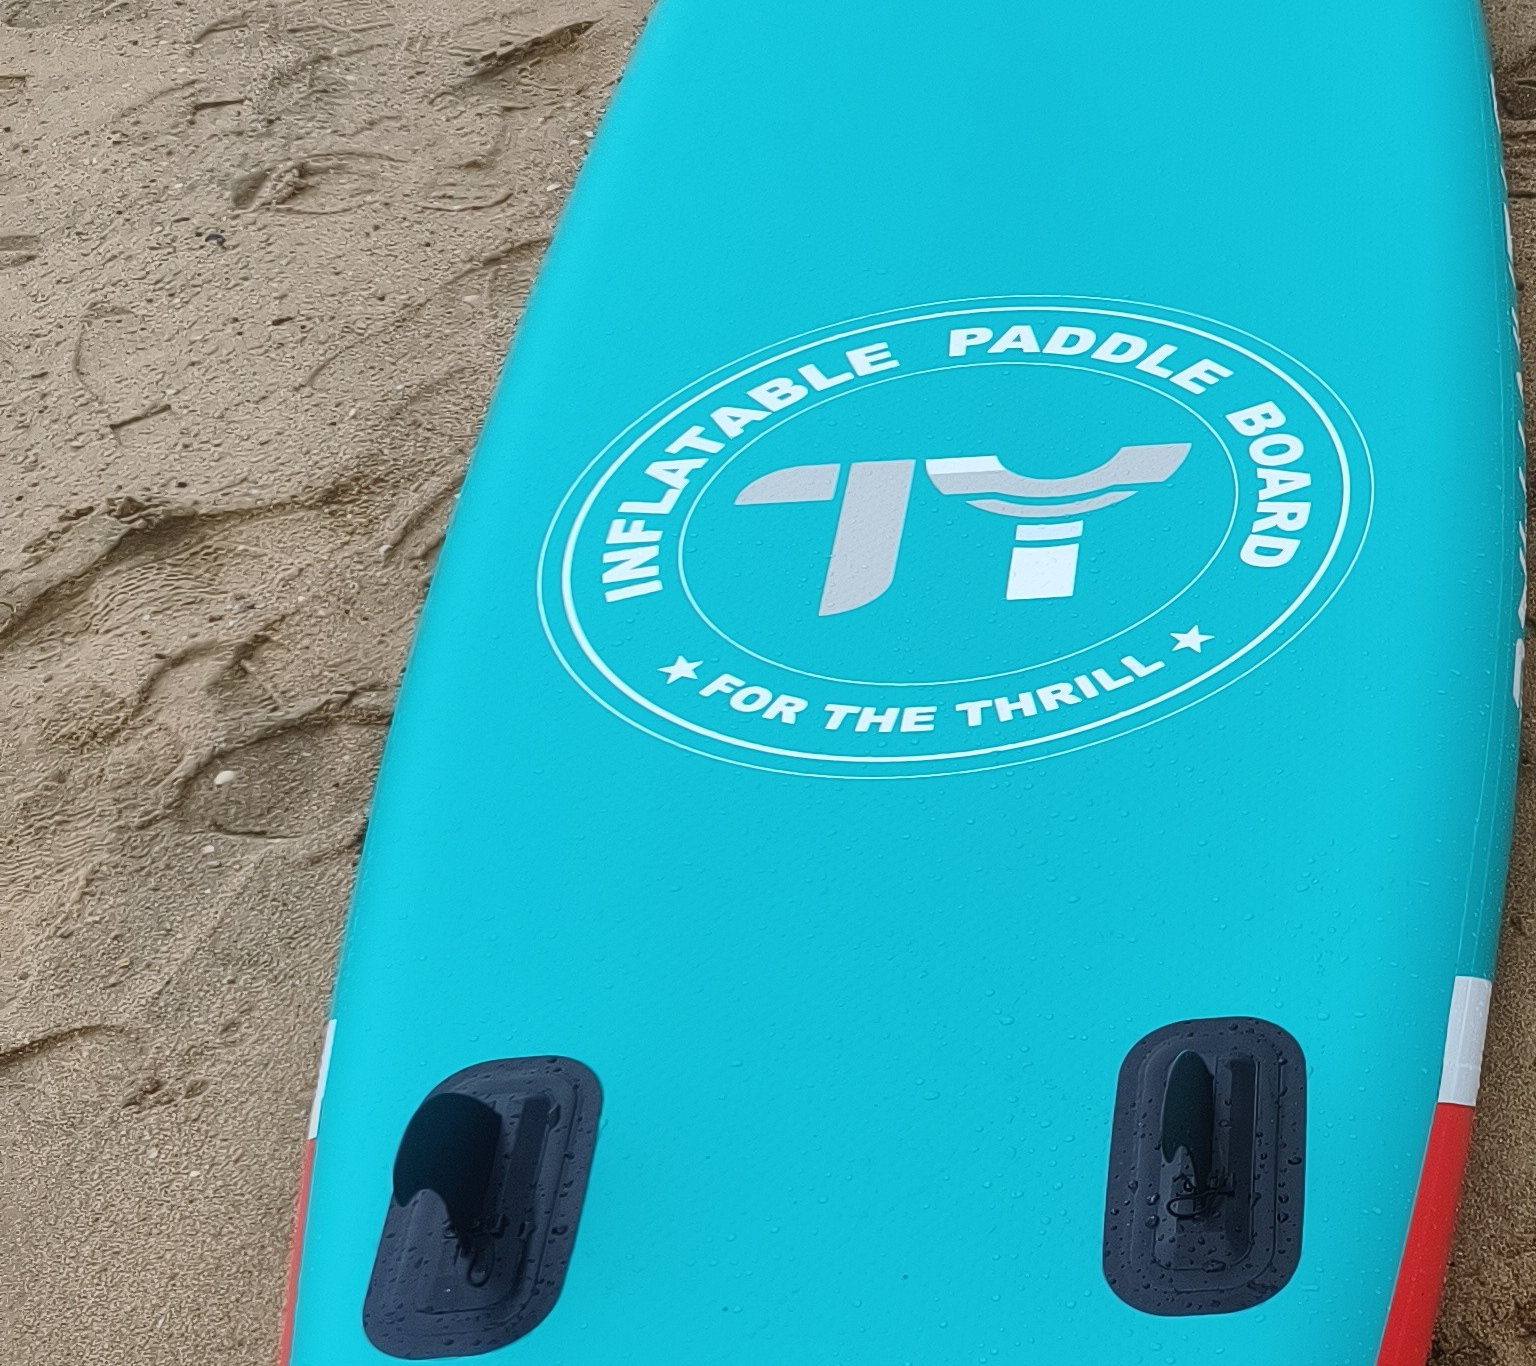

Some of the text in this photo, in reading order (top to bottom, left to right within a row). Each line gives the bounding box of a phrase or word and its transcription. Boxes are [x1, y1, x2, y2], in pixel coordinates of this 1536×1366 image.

[601, 325, 1312, 603] INFLATABLE PADDLE BOARD
[698, 655, 1165, 733] FOR THE THRILL
